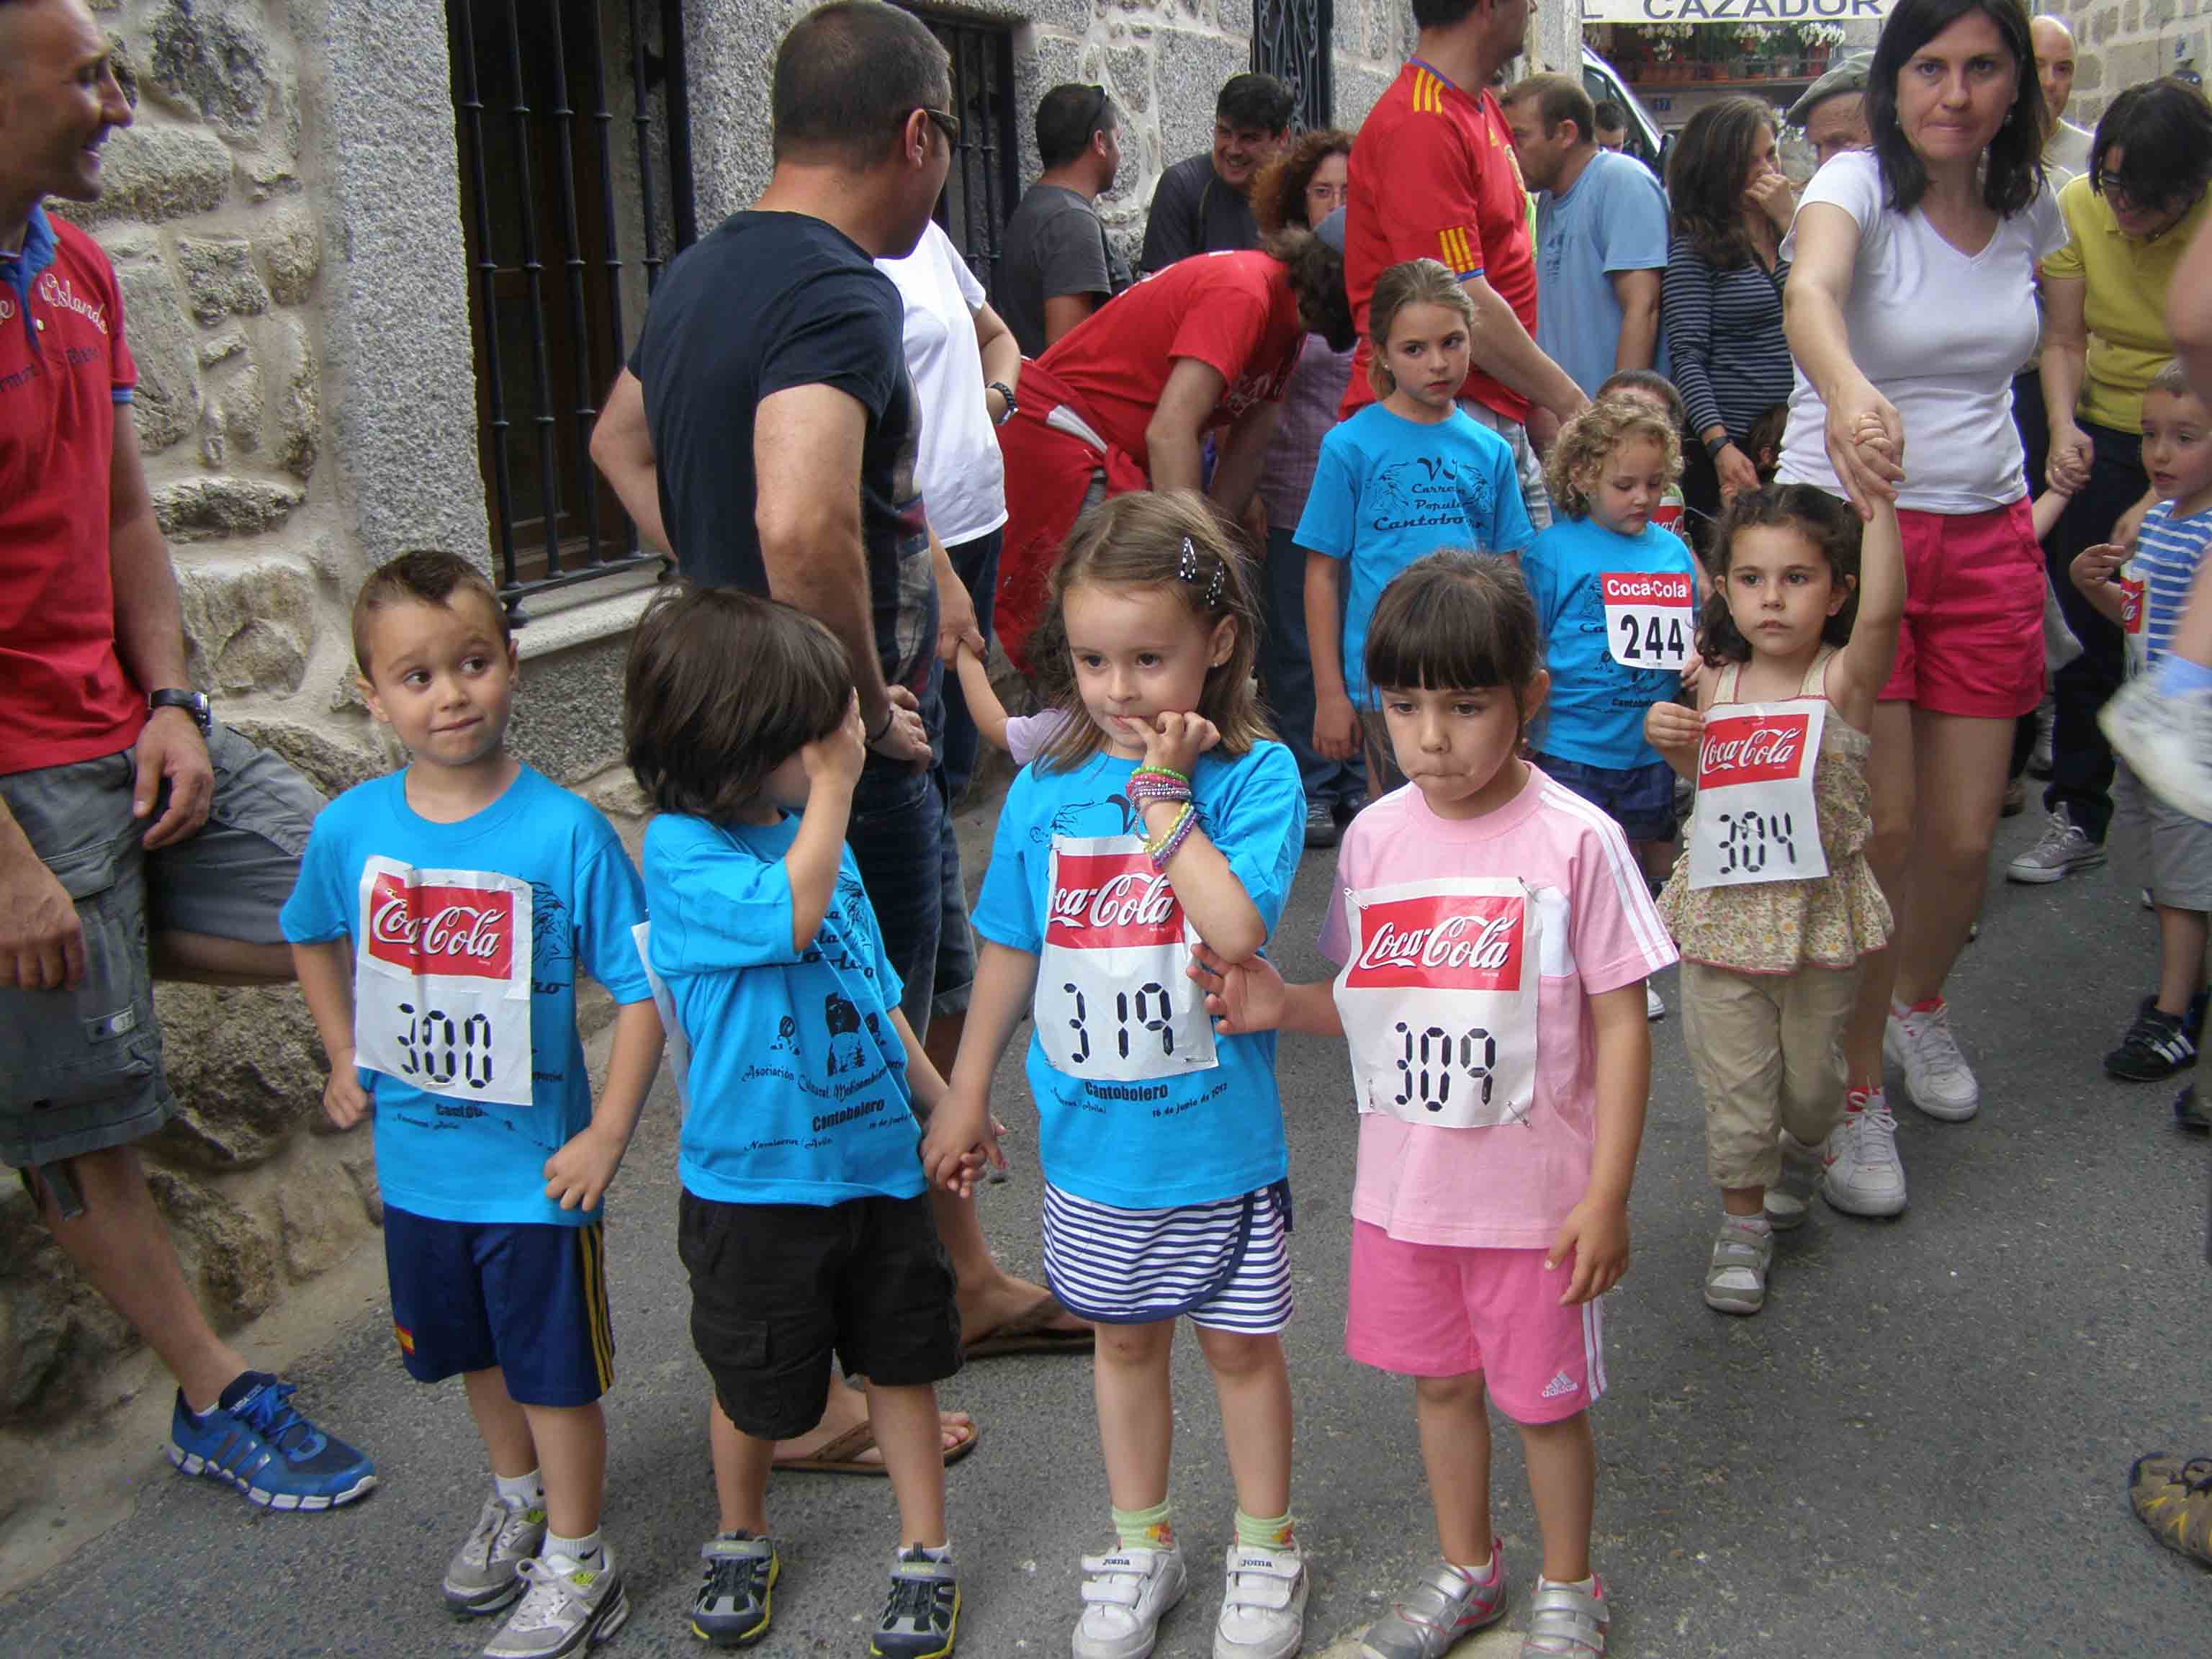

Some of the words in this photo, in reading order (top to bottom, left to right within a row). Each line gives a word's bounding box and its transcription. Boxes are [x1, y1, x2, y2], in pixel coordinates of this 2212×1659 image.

[1643, 0, 1884, 19] CAZADOR
[1606, 578, 1688, 598] Coca-Cola
[1620, 613, 1685, 660] 244
[1701, 727, 1802, 775] Coca-Cola
[1718, 811, 1797, 874] 304
[1049, 873, 1175, 928] ca-Cola
[1358, 915, 1518, 971] Coca-Cola
[397, 1002, 493, 1089] 300
[1063, 981, 1175, 1064] 319
[1085, 1081, 1169, 1102] Cantobolero
[1395, 1021, 1497, 1112] 309
